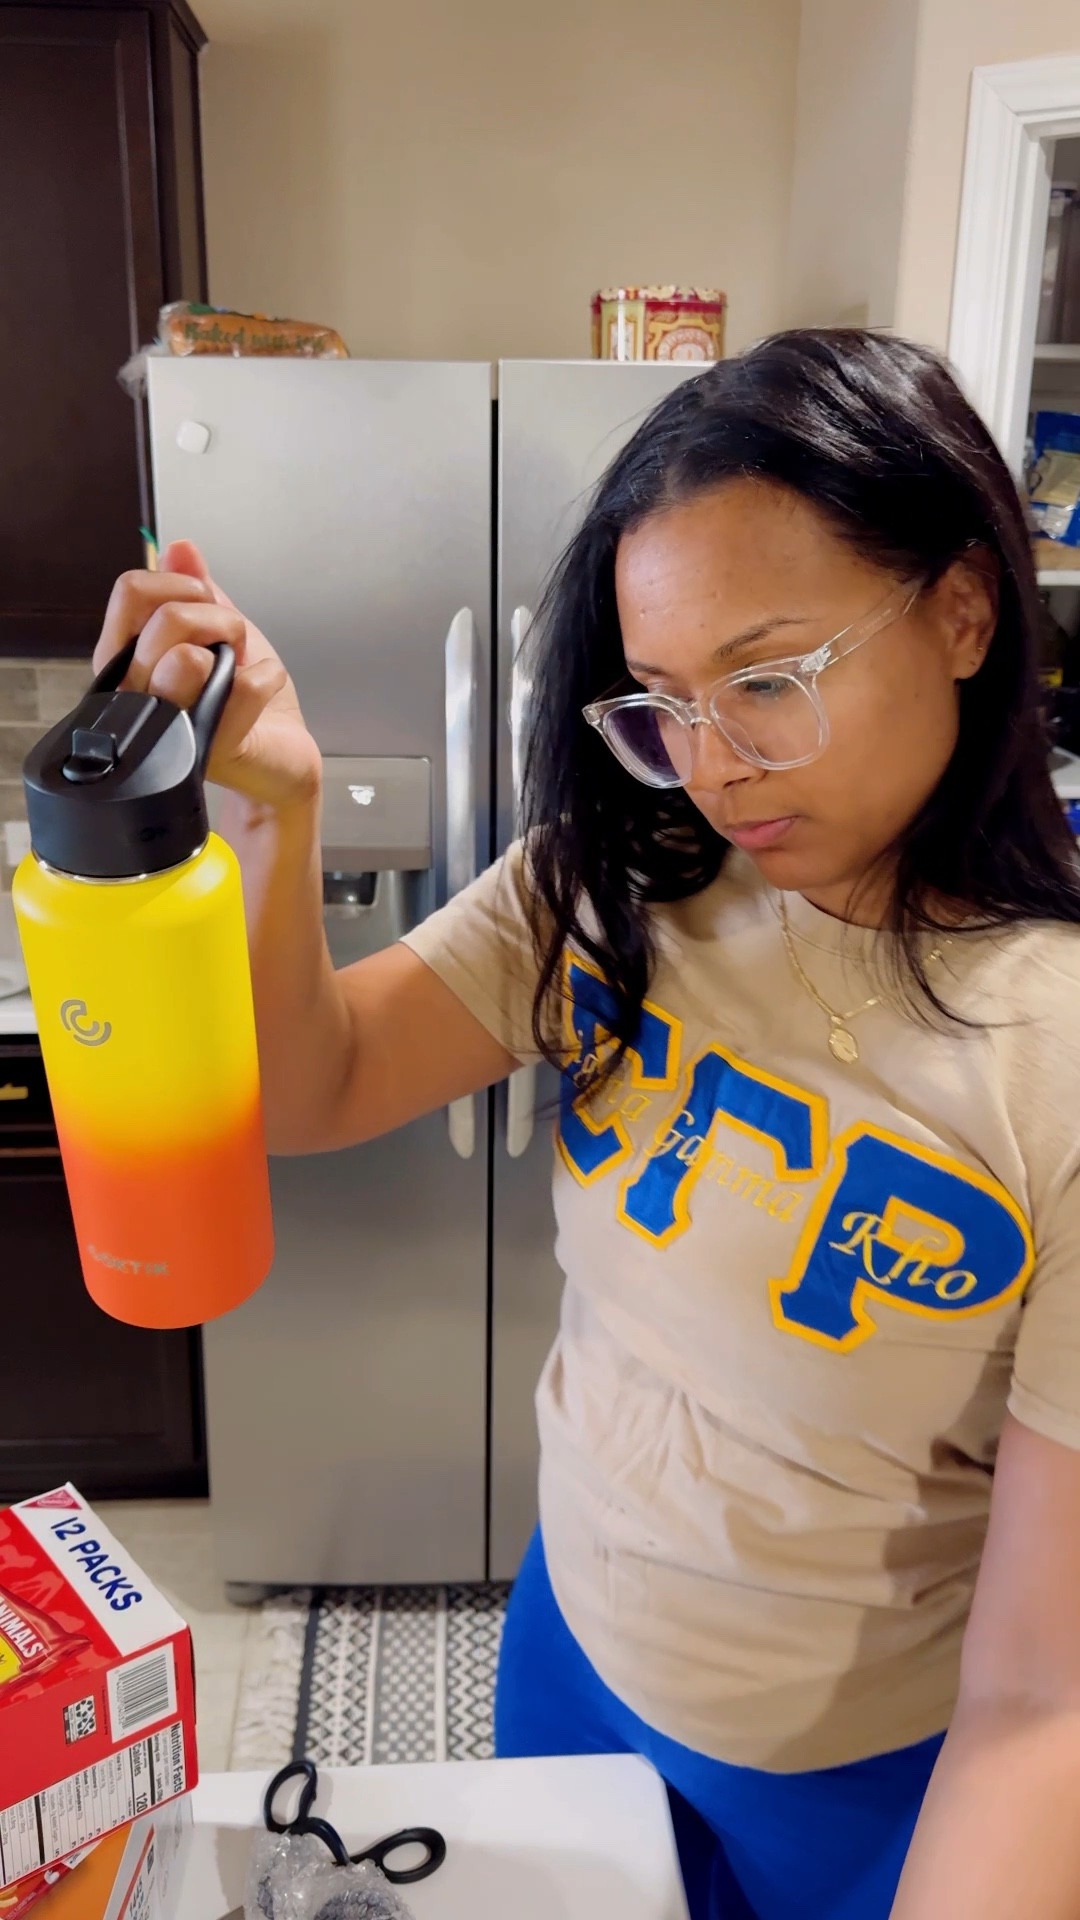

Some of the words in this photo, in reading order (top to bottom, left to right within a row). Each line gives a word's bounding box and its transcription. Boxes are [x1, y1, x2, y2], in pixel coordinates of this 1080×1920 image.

[829, 1211, 978, 1300] Rho
[51, 1517, 86, 1540] 12
[68, 1540, 143, 1611] PACKS
[132, 1741, 142, 1777] Calories
[170, 1723, 181, 1765] Nutrition
[173, 1765, 182, 1793] Facts
[135, 1790, 148, 1814] 120
